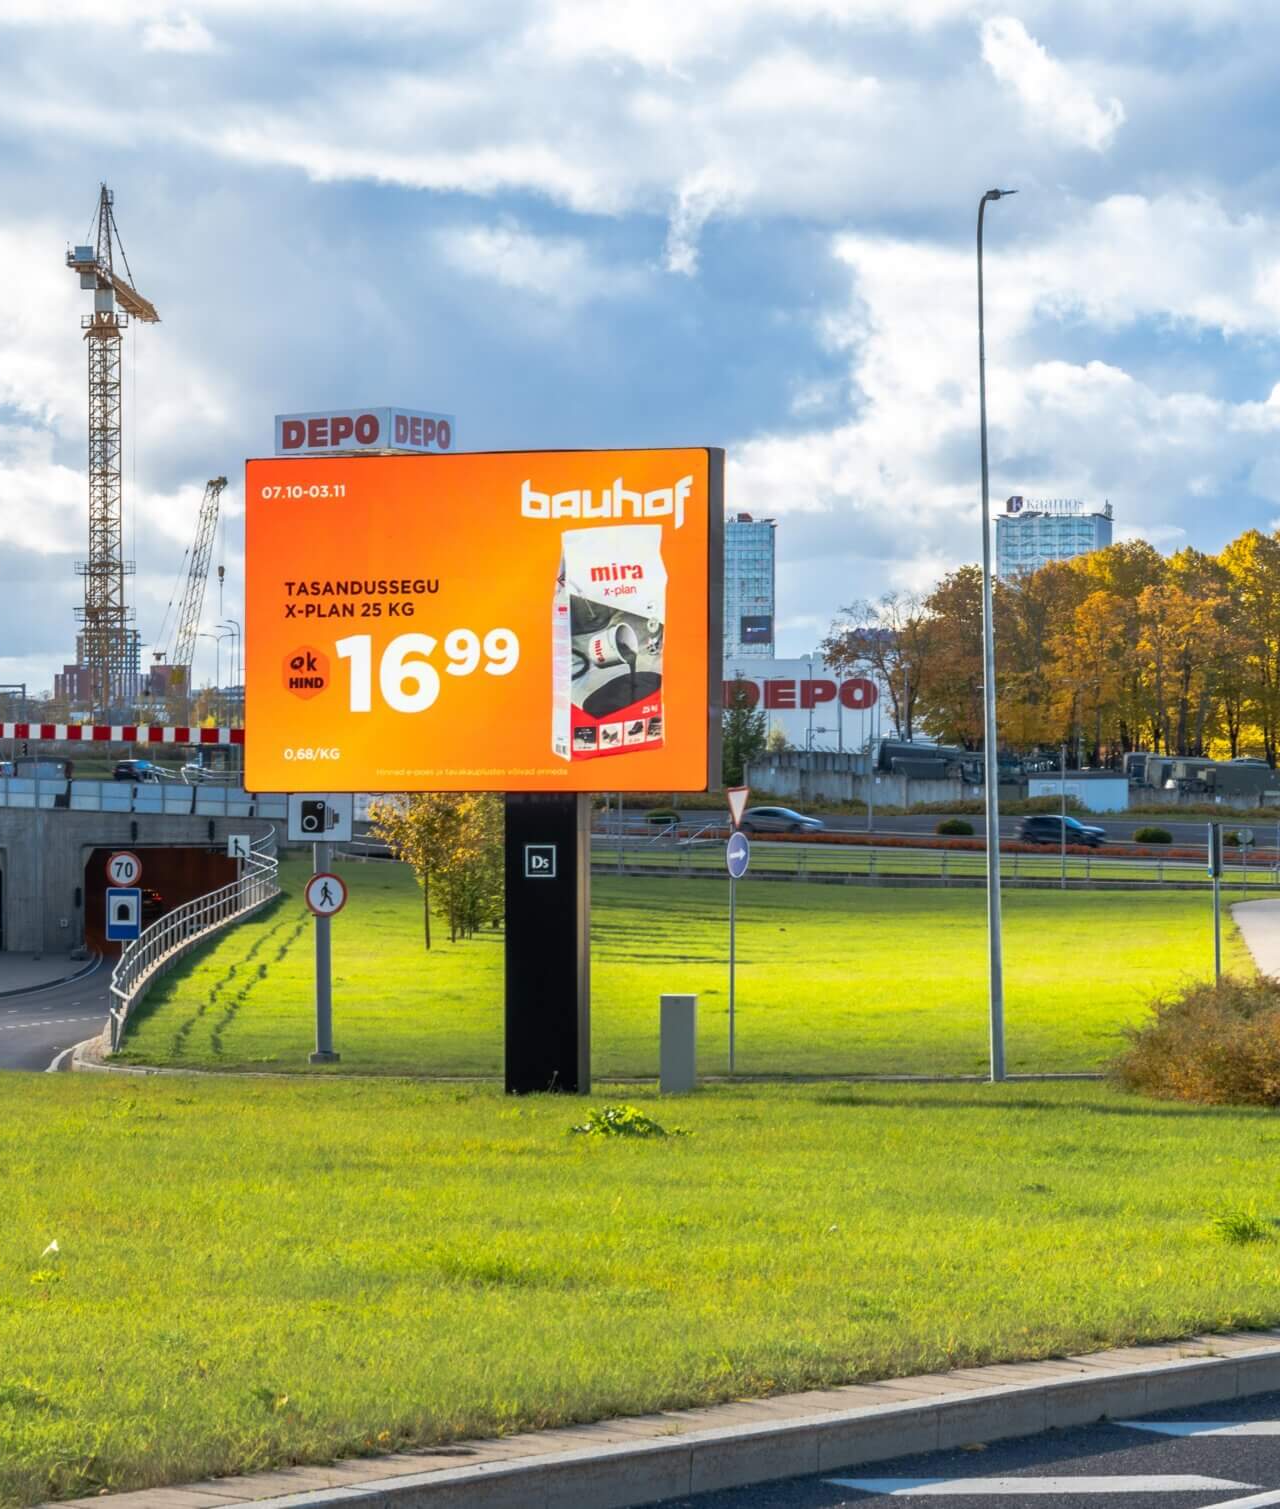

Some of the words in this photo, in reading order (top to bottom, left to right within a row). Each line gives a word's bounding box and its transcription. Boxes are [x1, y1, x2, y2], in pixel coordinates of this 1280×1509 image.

[282, 414, 380, 449] DEPO
[394, 414, 451, 450] DEPO
[261, 483, 347, 500] 07.10-03.11
[521, 475, 694, 530] bauhof
[590, 563, 644, 582] mira
[284, 579, 440, 596] TASANDUSSEGU
[603, 584, 637, 597] x-plan
[284, 603, 355, 618] X-PLAN
[360, 602, 382, 617] 25
[388, 601, 415, 616] KG
[288, 676, 324, 689] HIND
[720, 678, 878, 710] DEPO
[284, 747, 341, 761] 0,68/KG
[114, 861, 134, 878] 70
[531, 855, 550, 869] Ds
